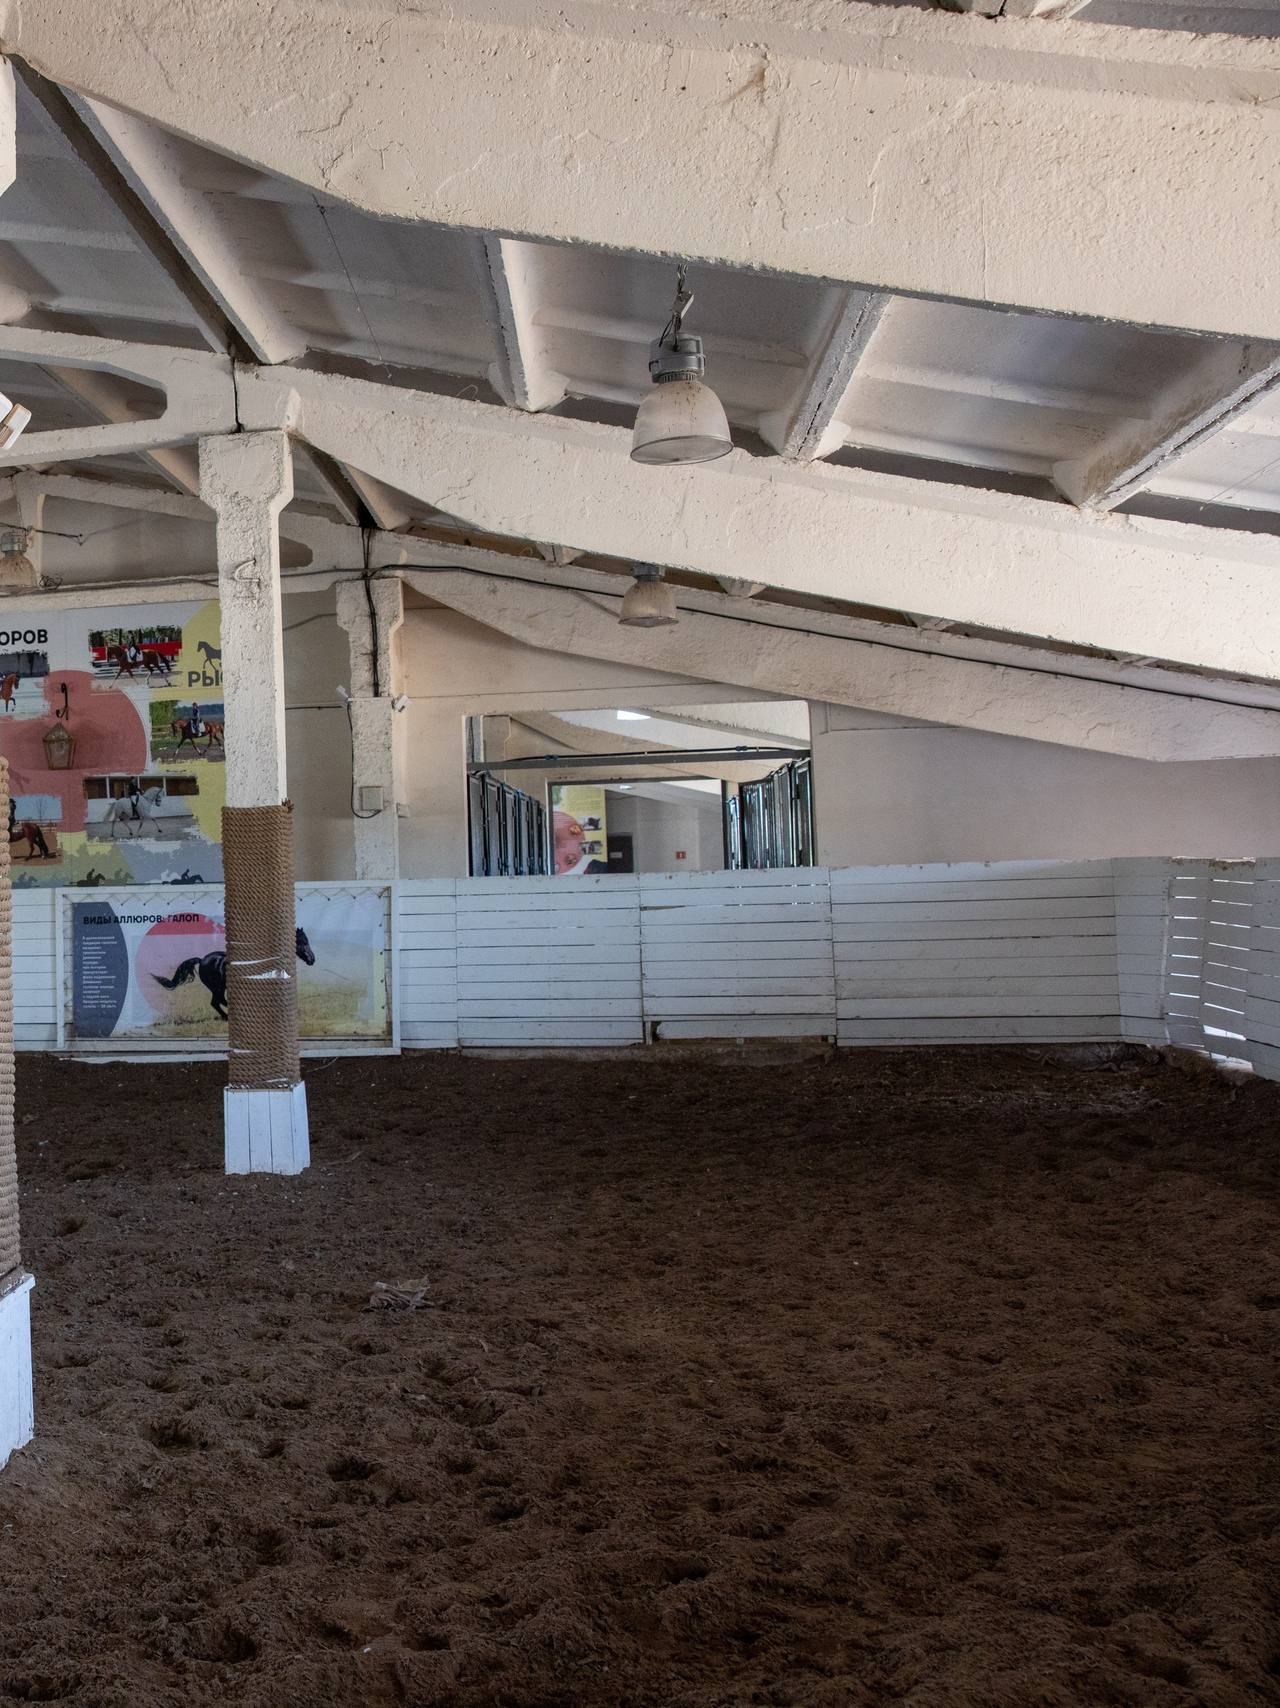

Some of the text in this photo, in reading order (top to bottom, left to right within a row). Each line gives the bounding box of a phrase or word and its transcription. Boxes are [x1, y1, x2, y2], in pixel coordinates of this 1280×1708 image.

[187, 669, 223, 688] РЫ
[83, 913, 200, 925] ВИДЫ АЛЛЮРОВ: ГАЛОП
